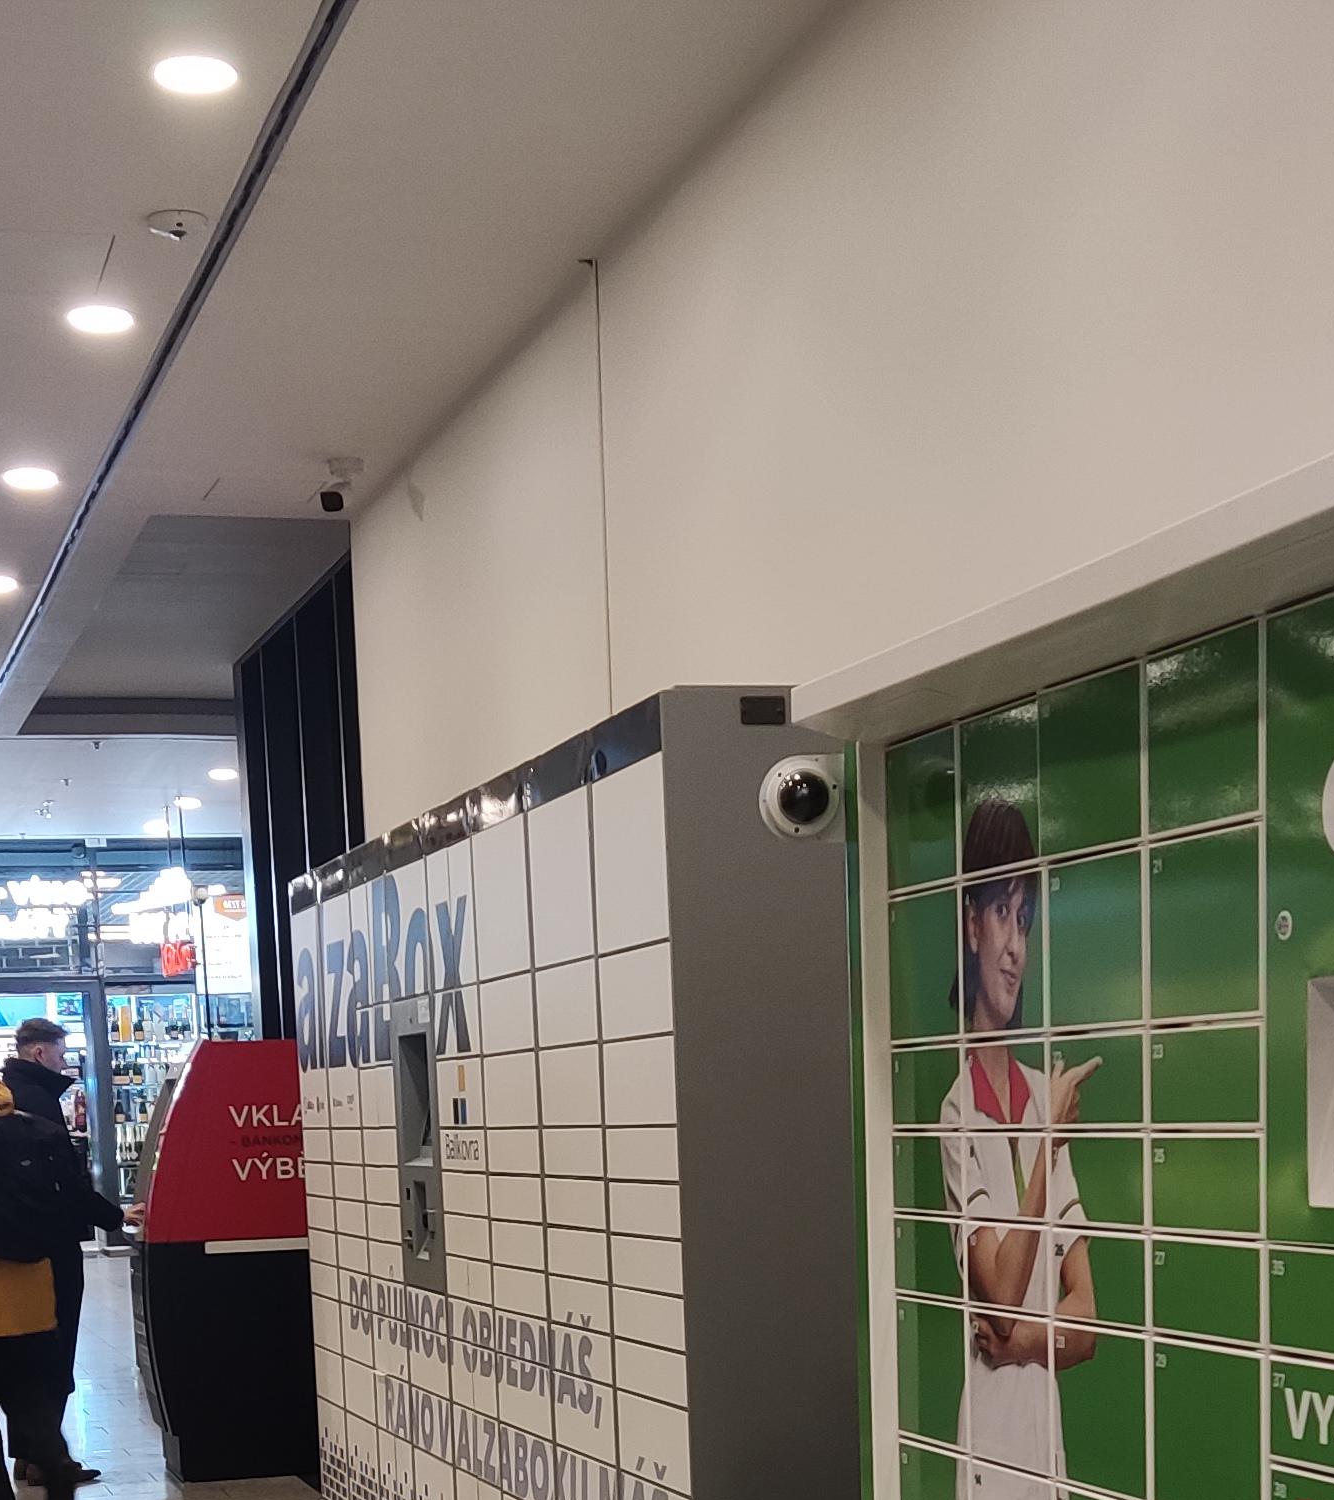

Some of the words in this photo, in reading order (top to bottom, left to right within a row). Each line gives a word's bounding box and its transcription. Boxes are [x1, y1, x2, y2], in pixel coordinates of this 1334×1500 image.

[296, 874, 472, 1073] alzaBox
[348, 1275, 372, 1335] DO
[461, 1305, 603, 1429] OBJEDNÁŠ,
[384, 1364, 435, 1450] RÁNO
[437, 1398, 451, 1458] V
[1272, 1372, 1286, 1388] 37
